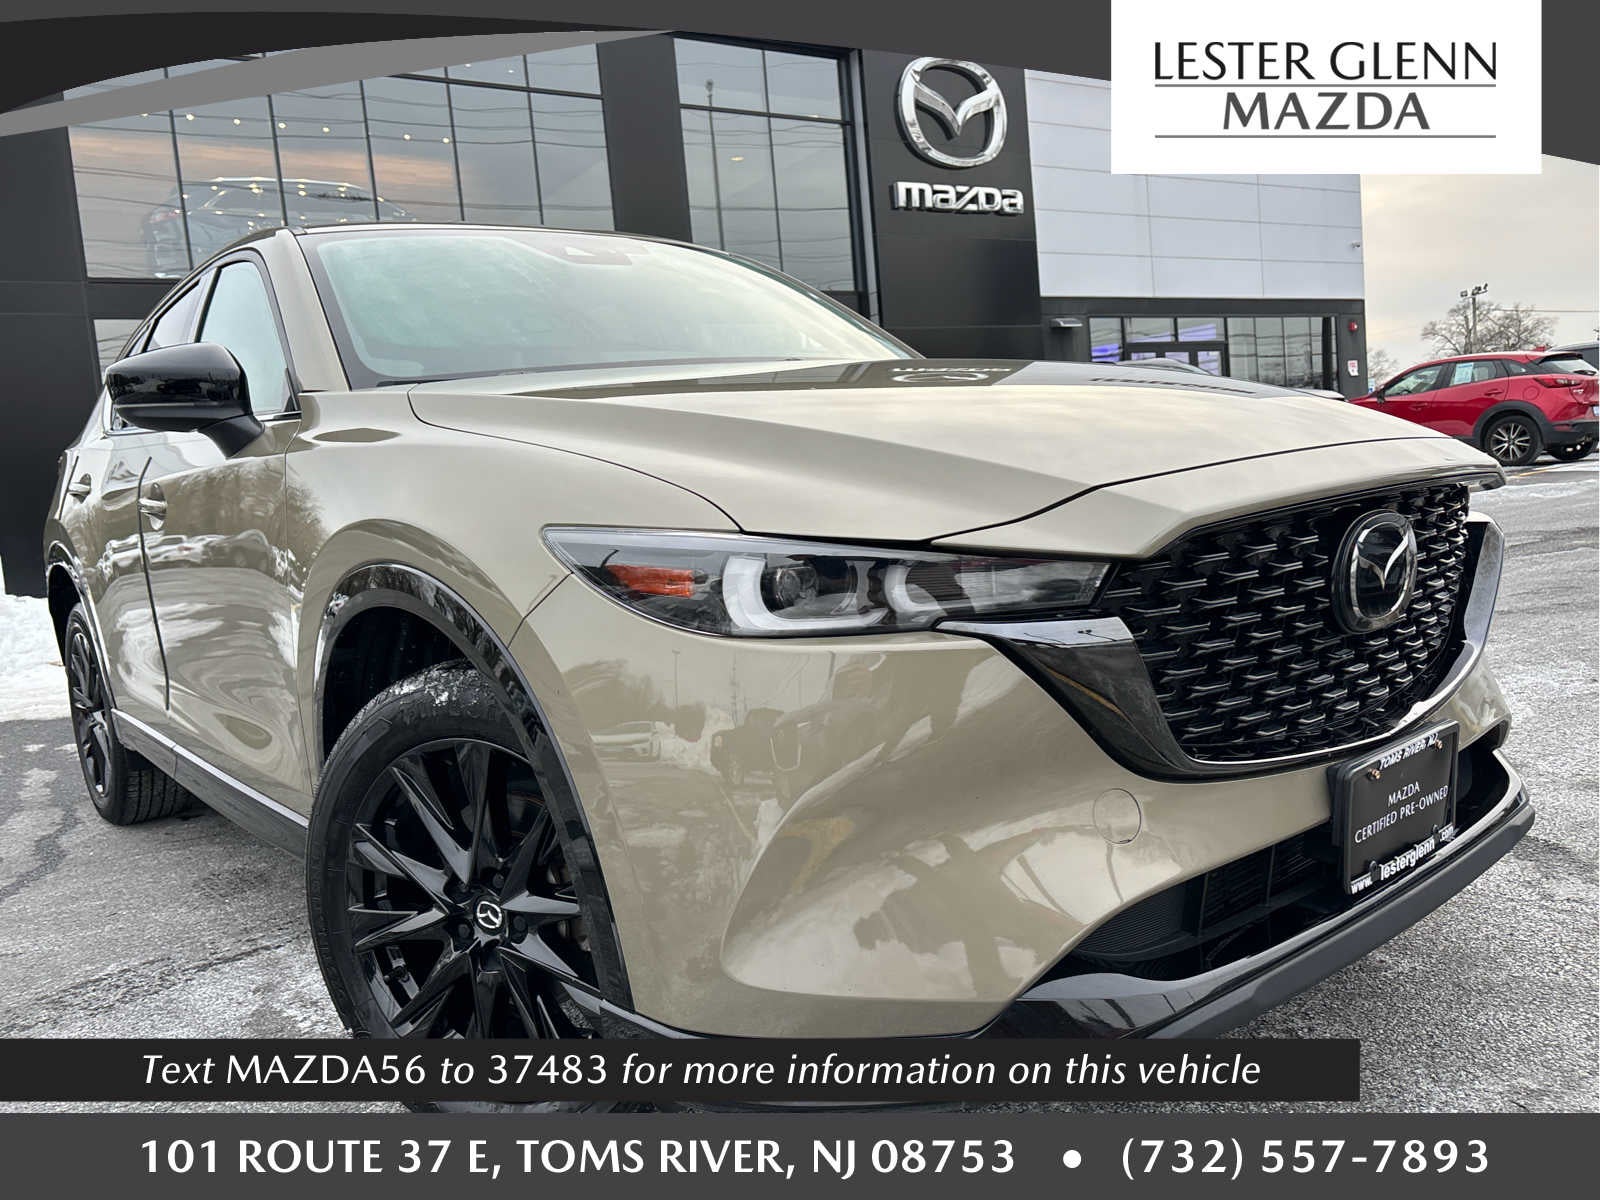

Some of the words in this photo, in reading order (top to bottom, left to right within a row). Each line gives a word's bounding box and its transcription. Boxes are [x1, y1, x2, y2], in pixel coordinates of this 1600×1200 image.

[1354, 811, 1398, 844] CERTIFIED
[1399, 785, 1449, 821] PRE-OWNED
[1387, 781, 1420, 806] MAZDA
